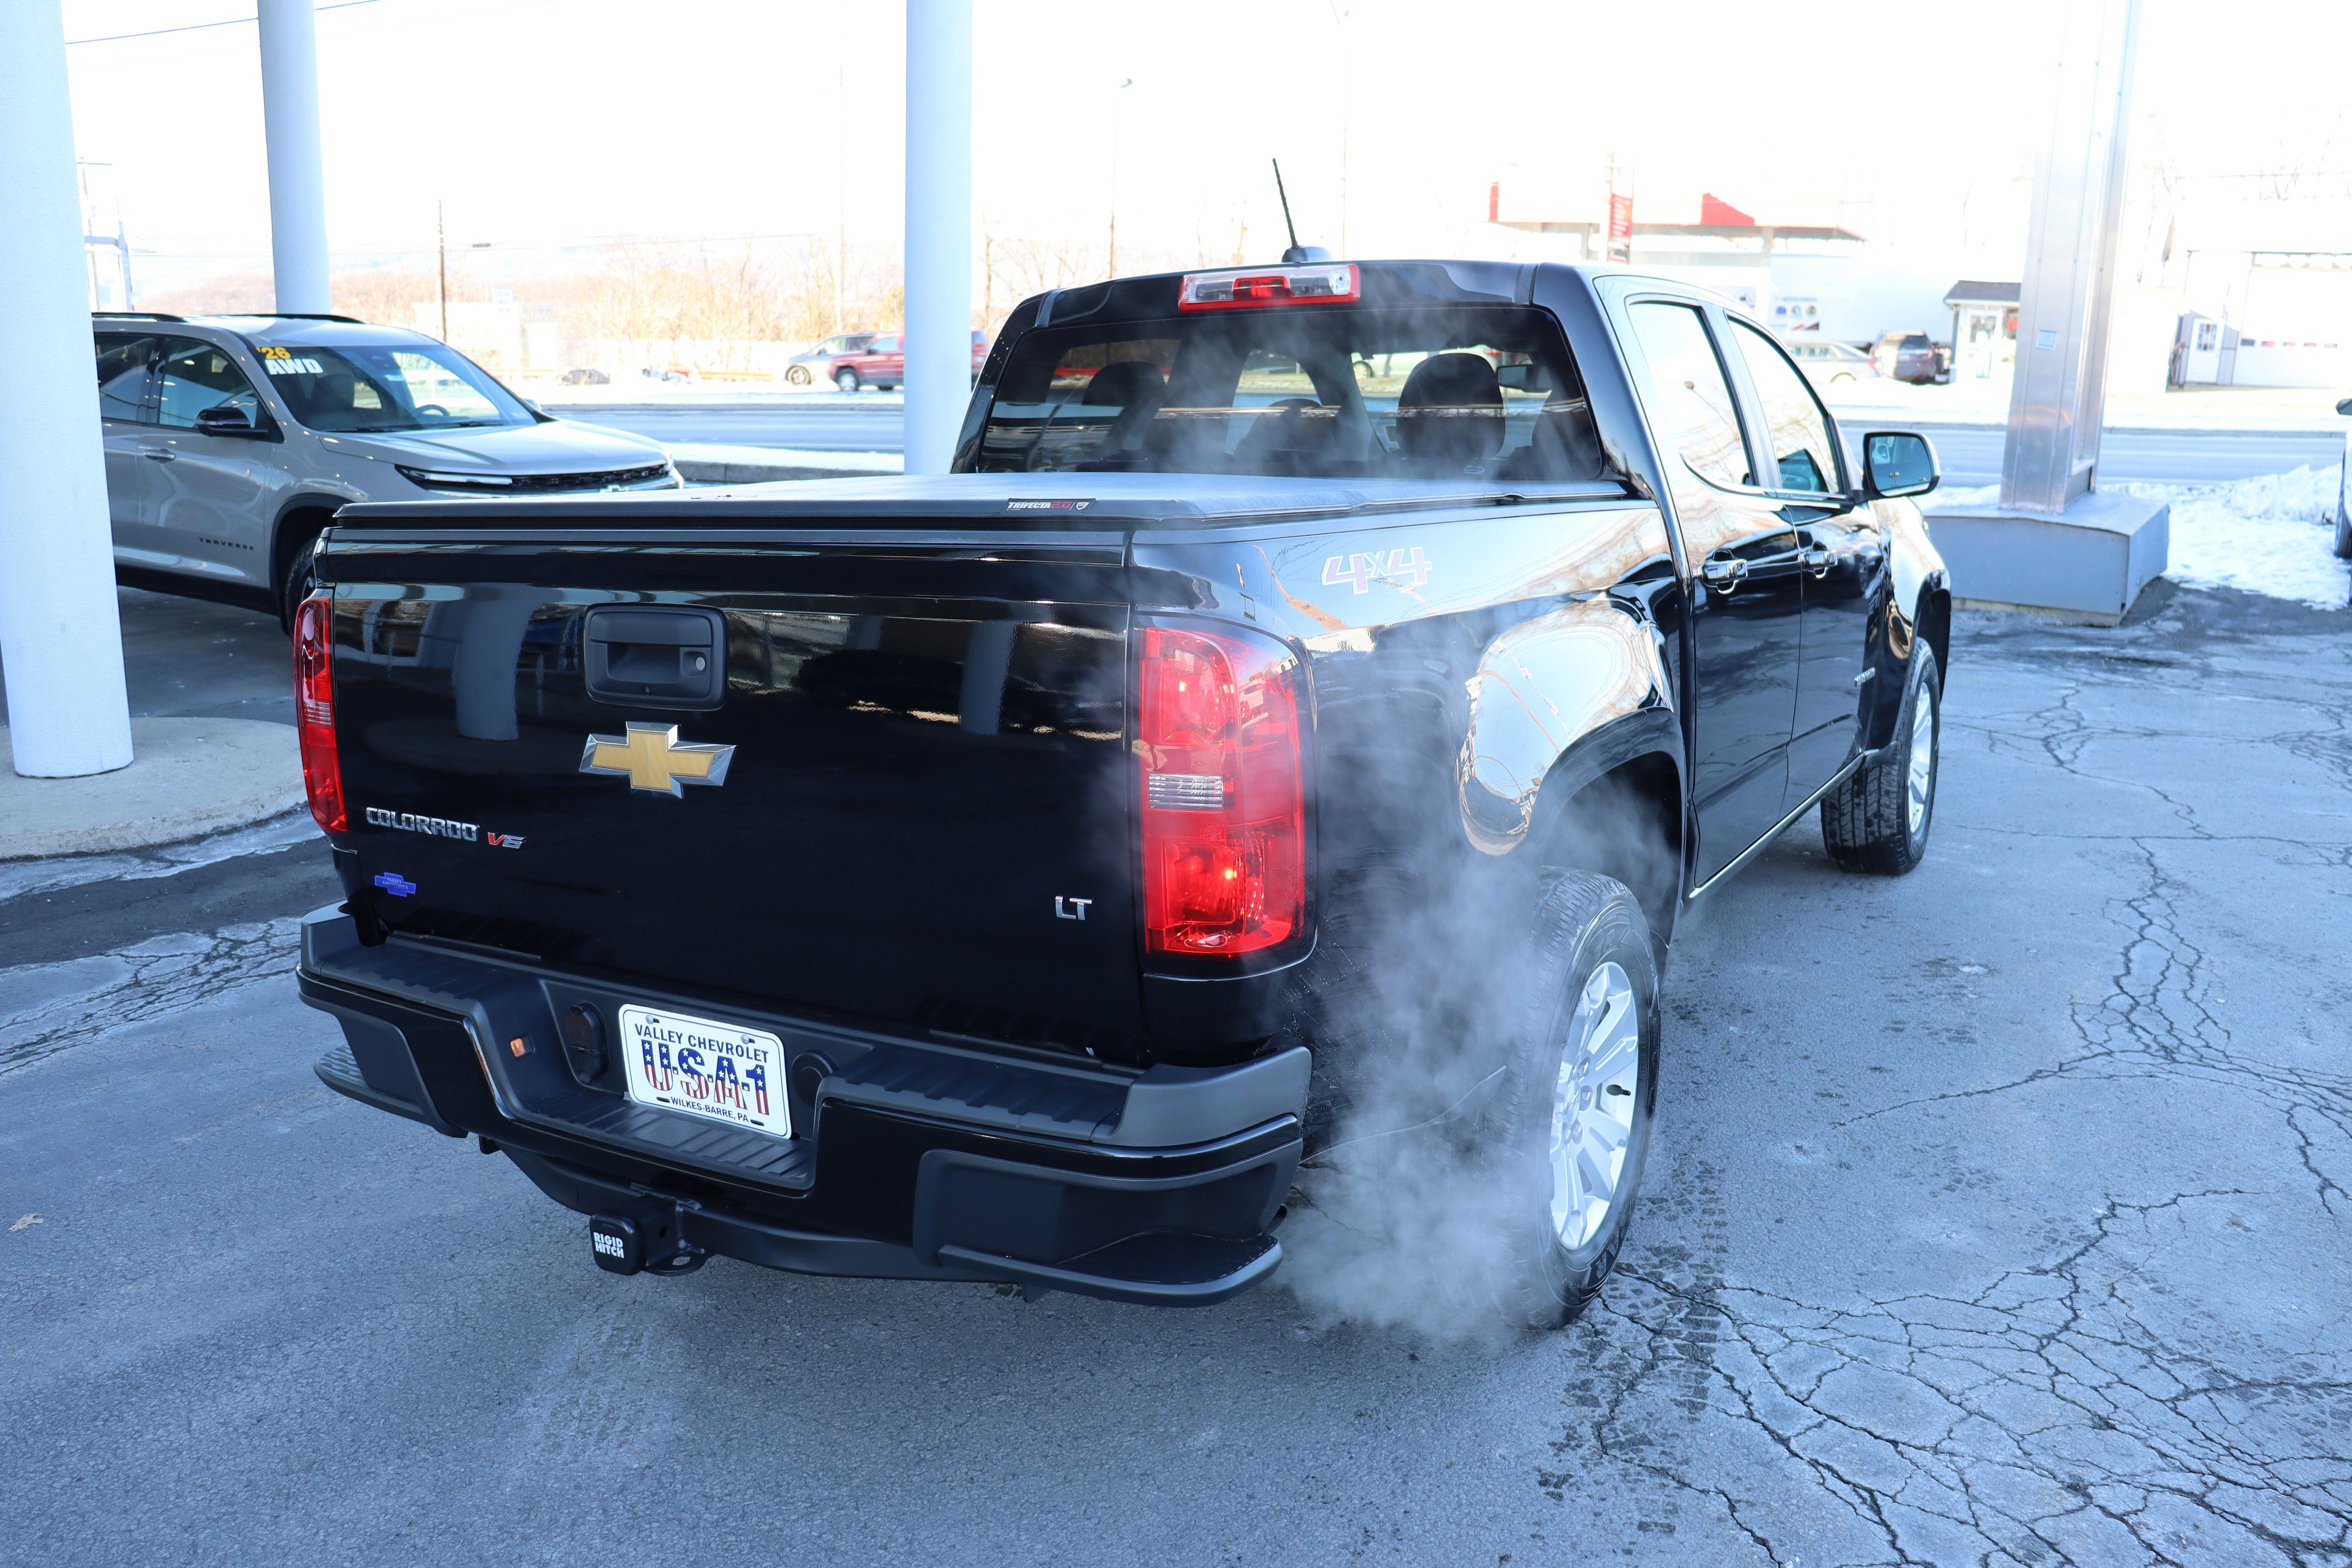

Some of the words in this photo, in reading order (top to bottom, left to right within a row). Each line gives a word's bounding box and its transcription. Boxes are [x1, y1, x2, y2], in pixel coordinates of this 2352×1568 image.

[256, 347, 291, 359] '26
[265, 359, 323, 375] AWD
[199, 538, 254, 550] TRAVERSE
[366, 807, 480, 842] COLORADO
[488, 831, 527, 849] V6
[1055, 895, 1093, 920] LT
[635, 1023, 683, 1044] VALLEY
[688, 1035, 768, 1063] CHEVROLET
[670, 1096, 735, 1120] WILKES-BARRE,
[737, 1112, 749, 1122] PA
[593, 1232, 624, 1248] RIGID
[595, 1241, 624, 1258] HITCH
